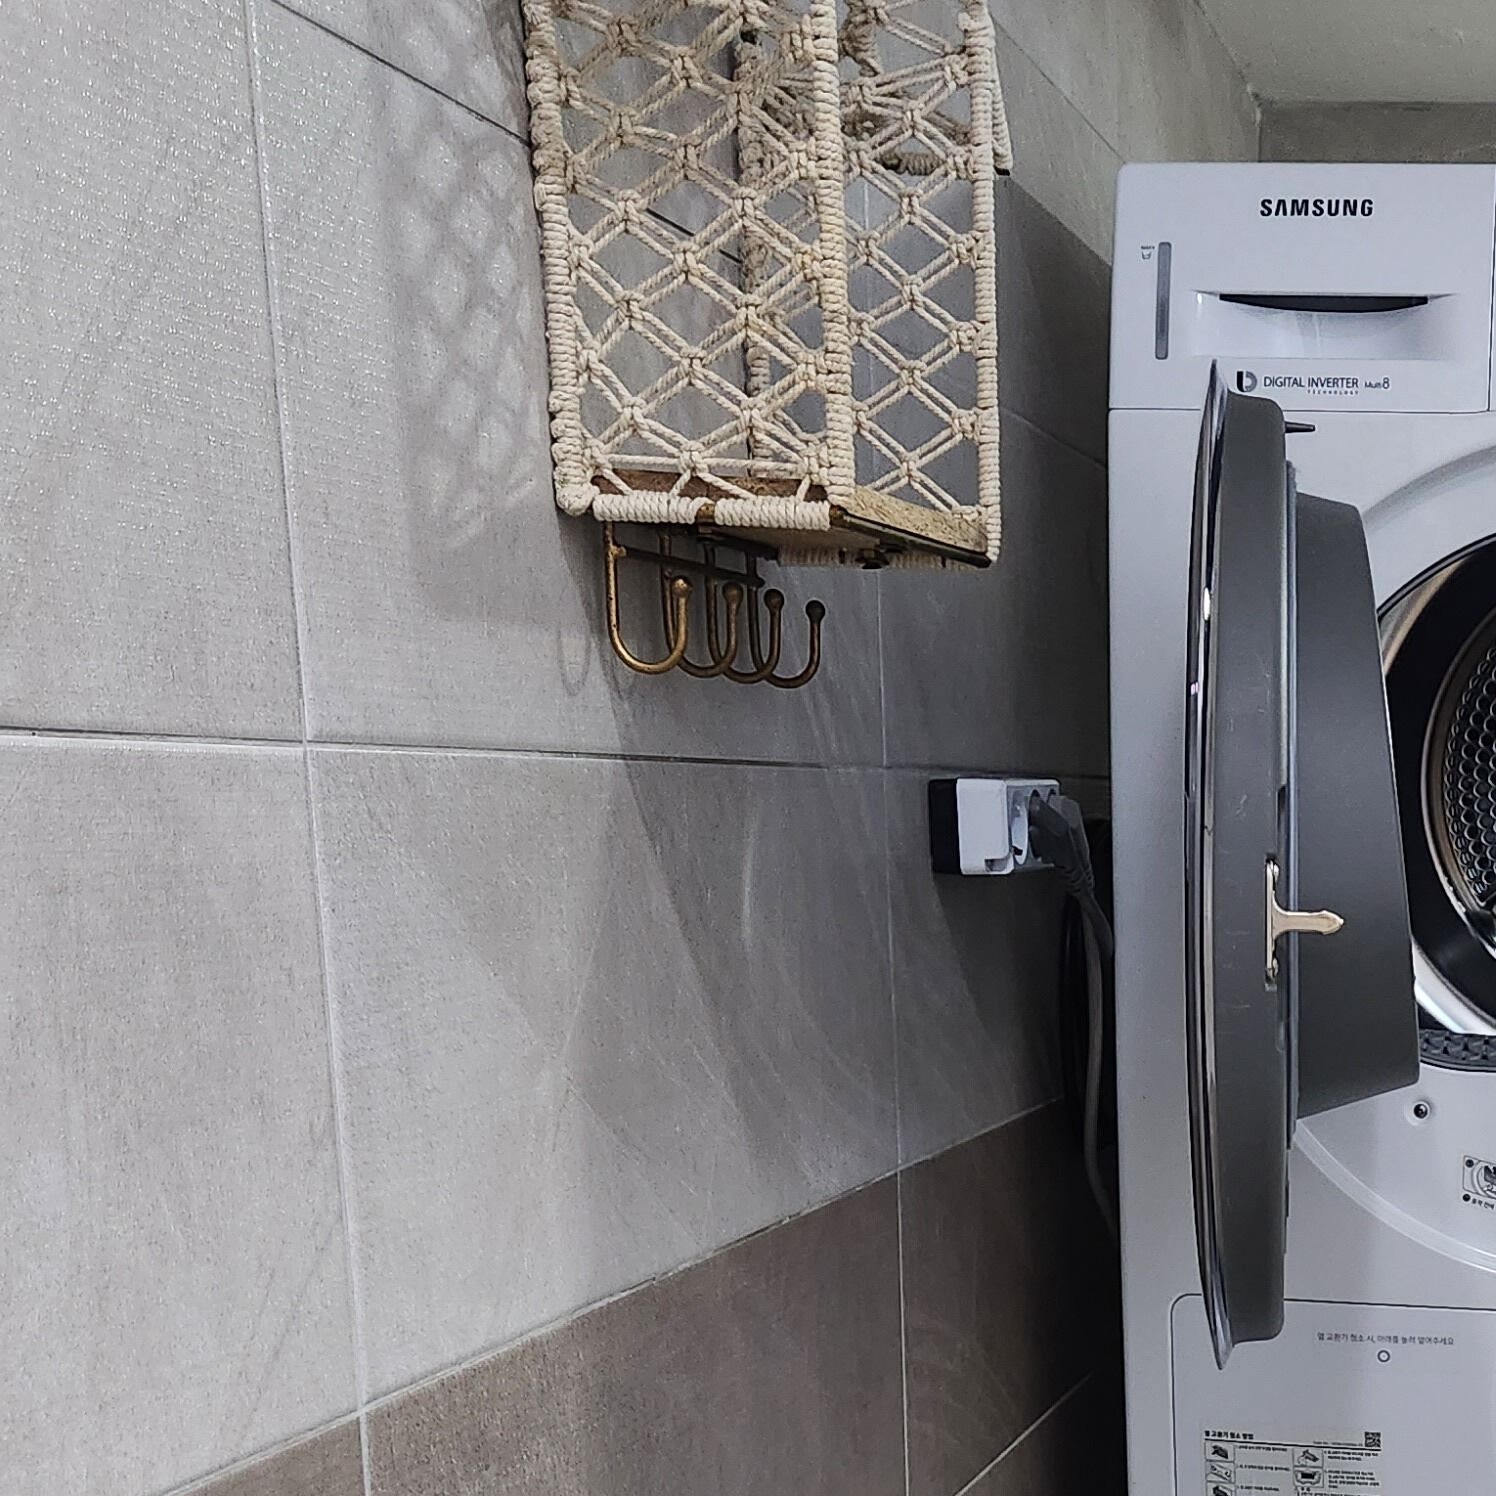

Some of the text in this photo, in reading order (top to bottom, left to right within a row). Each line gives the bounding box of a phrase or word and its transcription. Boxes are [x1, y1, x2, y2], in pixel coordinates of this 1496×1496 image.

[1260, 199, 1374, 217] SAMSUNG
[1263, 376, 1304, 388] DIGITAL
[1308, 377, 1359, 389] INVERTER
